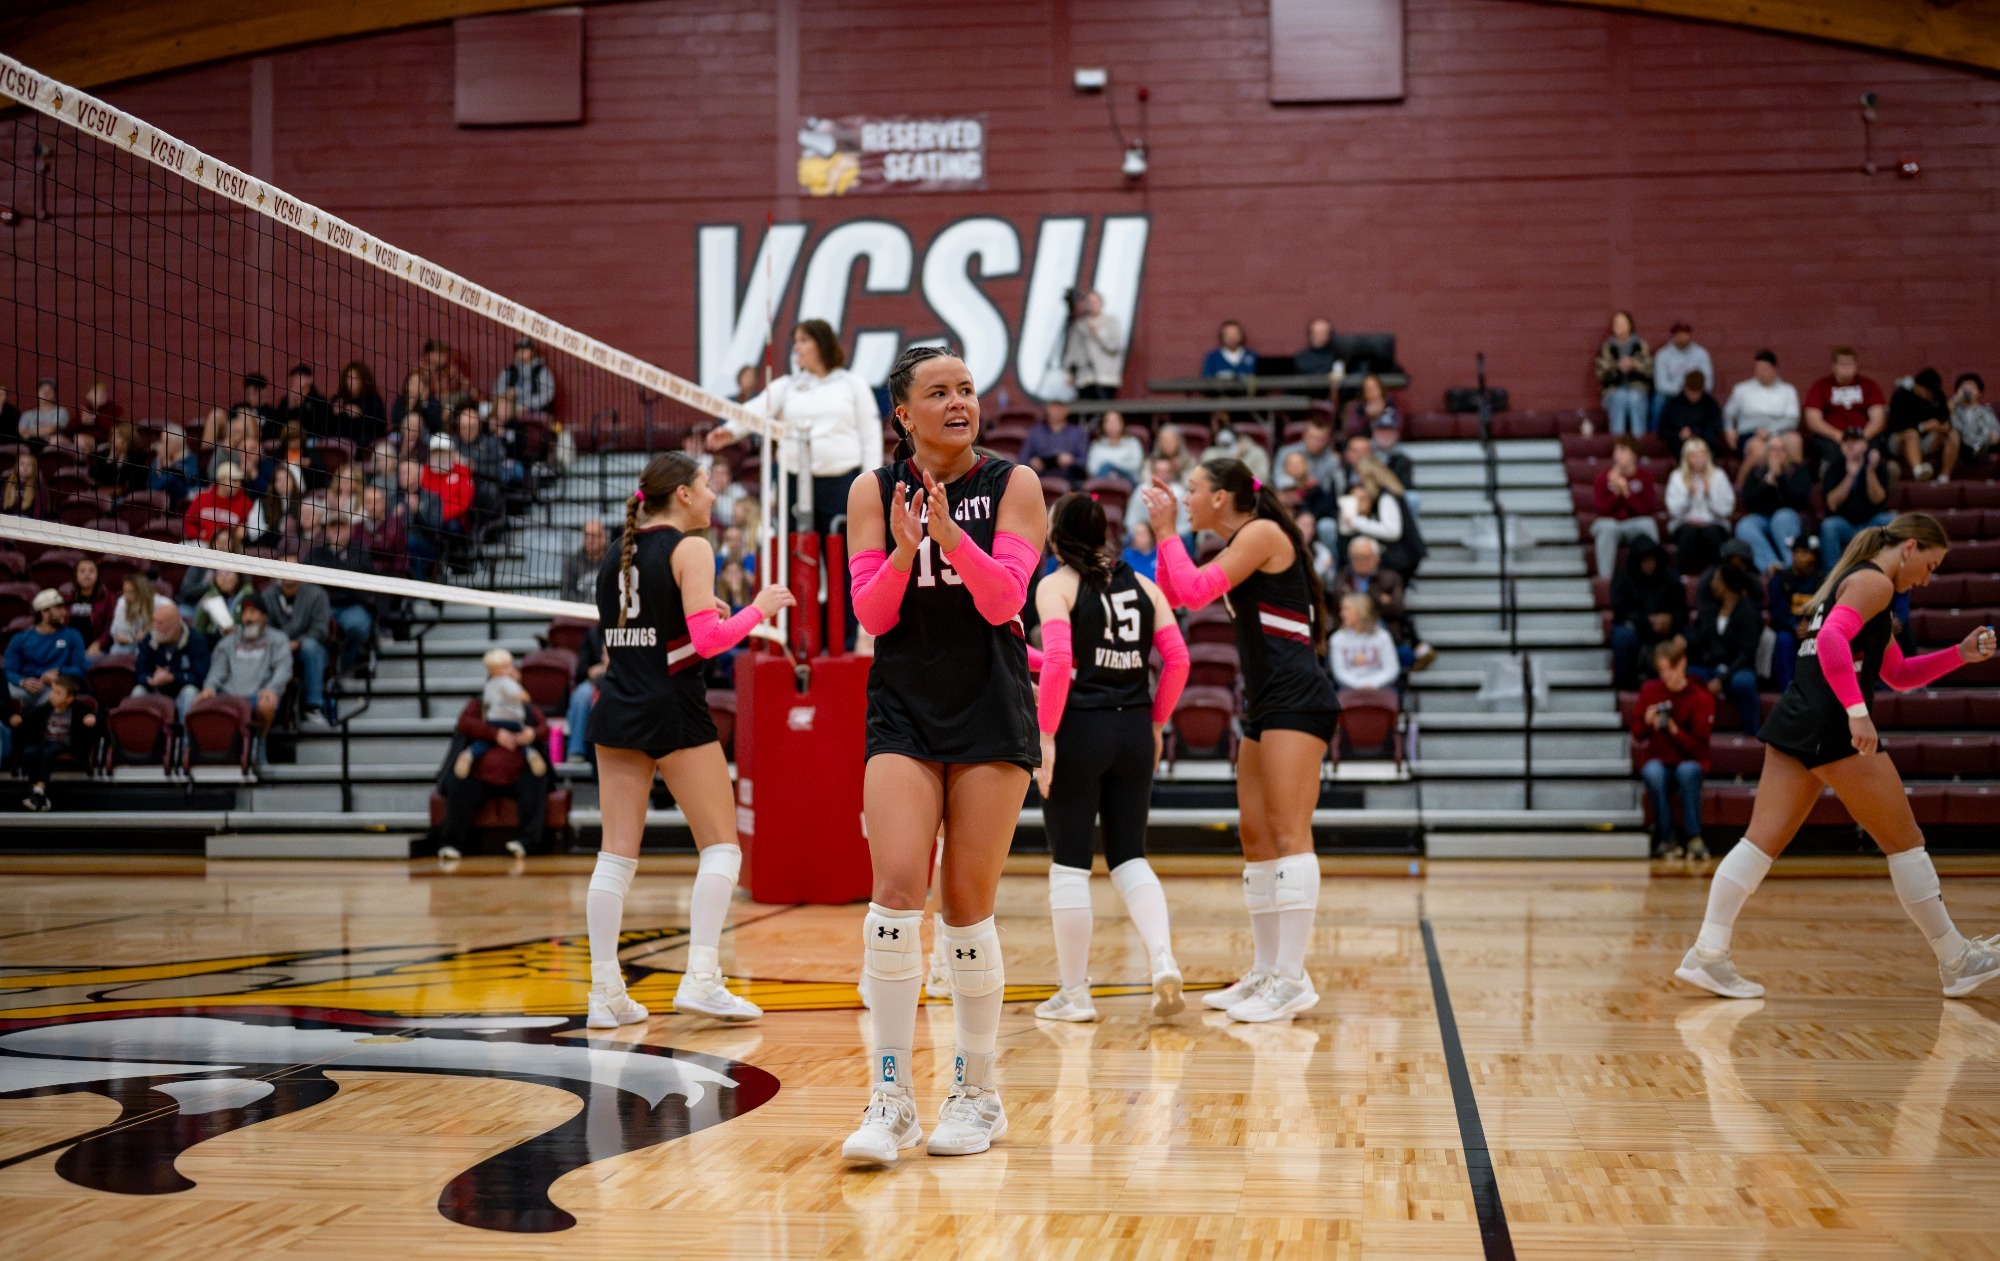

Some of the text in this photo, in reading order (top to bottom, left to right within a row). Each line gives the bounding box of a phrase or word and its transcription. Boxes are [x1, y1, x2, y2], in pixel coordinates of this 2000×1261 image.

[861, 120, 982, 152] RESERVED
[883, 151, 982, 182] SEATING
[77, 100, 118, 137] VCSU
[150, 134, 185, 171] VCSU
[215, 167, 248, 199] VCSU
[273, 195, 303, 226] VCSU
[327, 221, 353, 248] VCSU
[375, 244, 399, 271] VCSU
[419, 265, 442, 290] VCSU
[460, 284, 481, 307] VCSU
[497, 301, 516, 323] VCSU
[696, 213, 1151, 400] VCSU
[955, 495, 991, 521] CITY
[618, 565, 641, 619] 8
[605, 626, 657, 648] VIKINGS
[1100, 588, 1142, 645] 15
